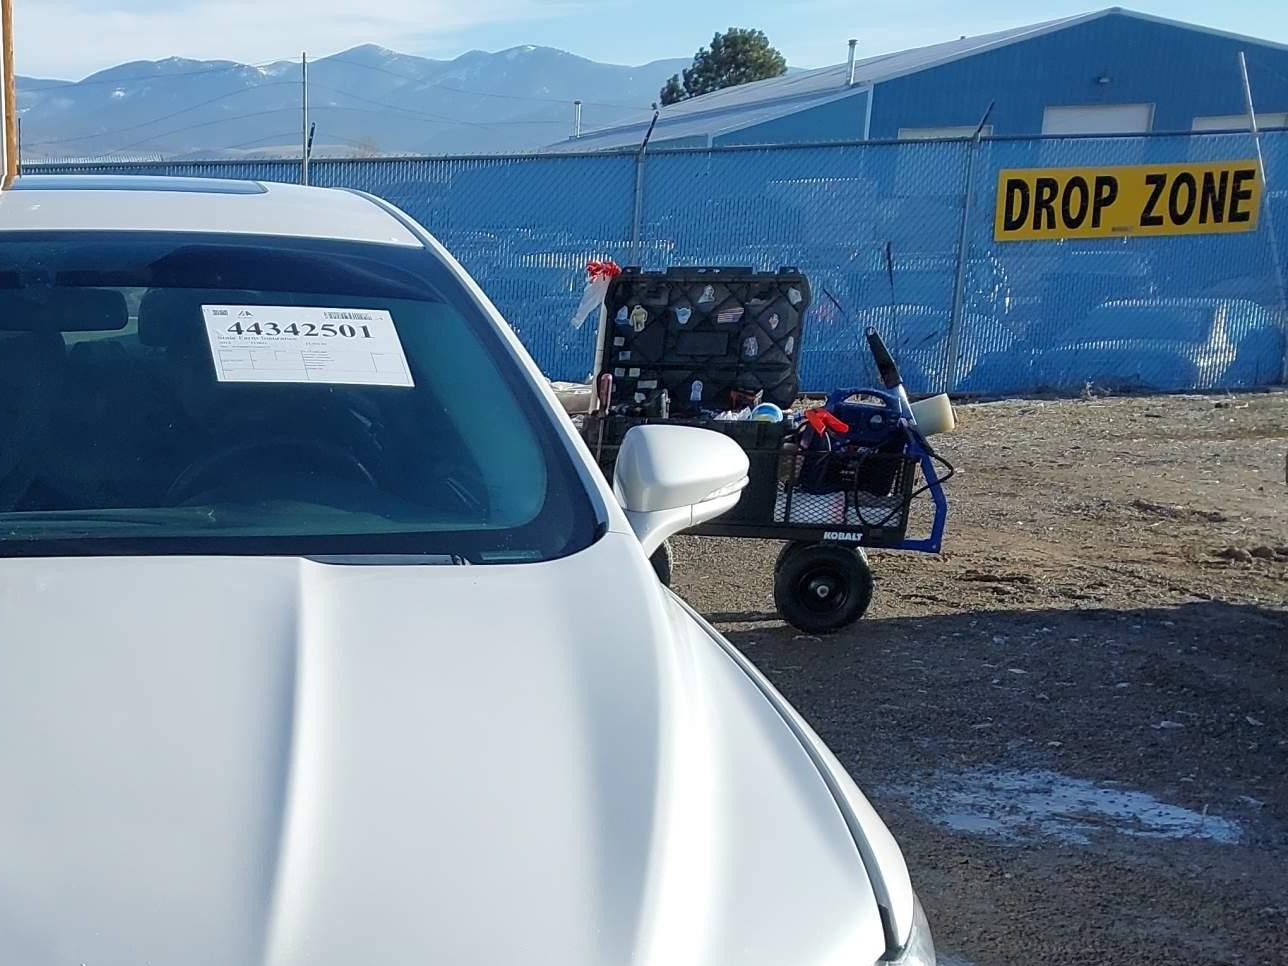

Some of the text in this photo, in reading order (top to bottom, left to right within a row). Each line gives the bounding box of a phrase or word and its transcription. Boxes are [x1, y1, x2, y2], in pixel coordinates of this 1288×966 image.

[1003, 169, 1256, 232] DROP ZONE
[226, 320, 376, 339] 44342501
[823, 531, 863, 541] KOBALT
